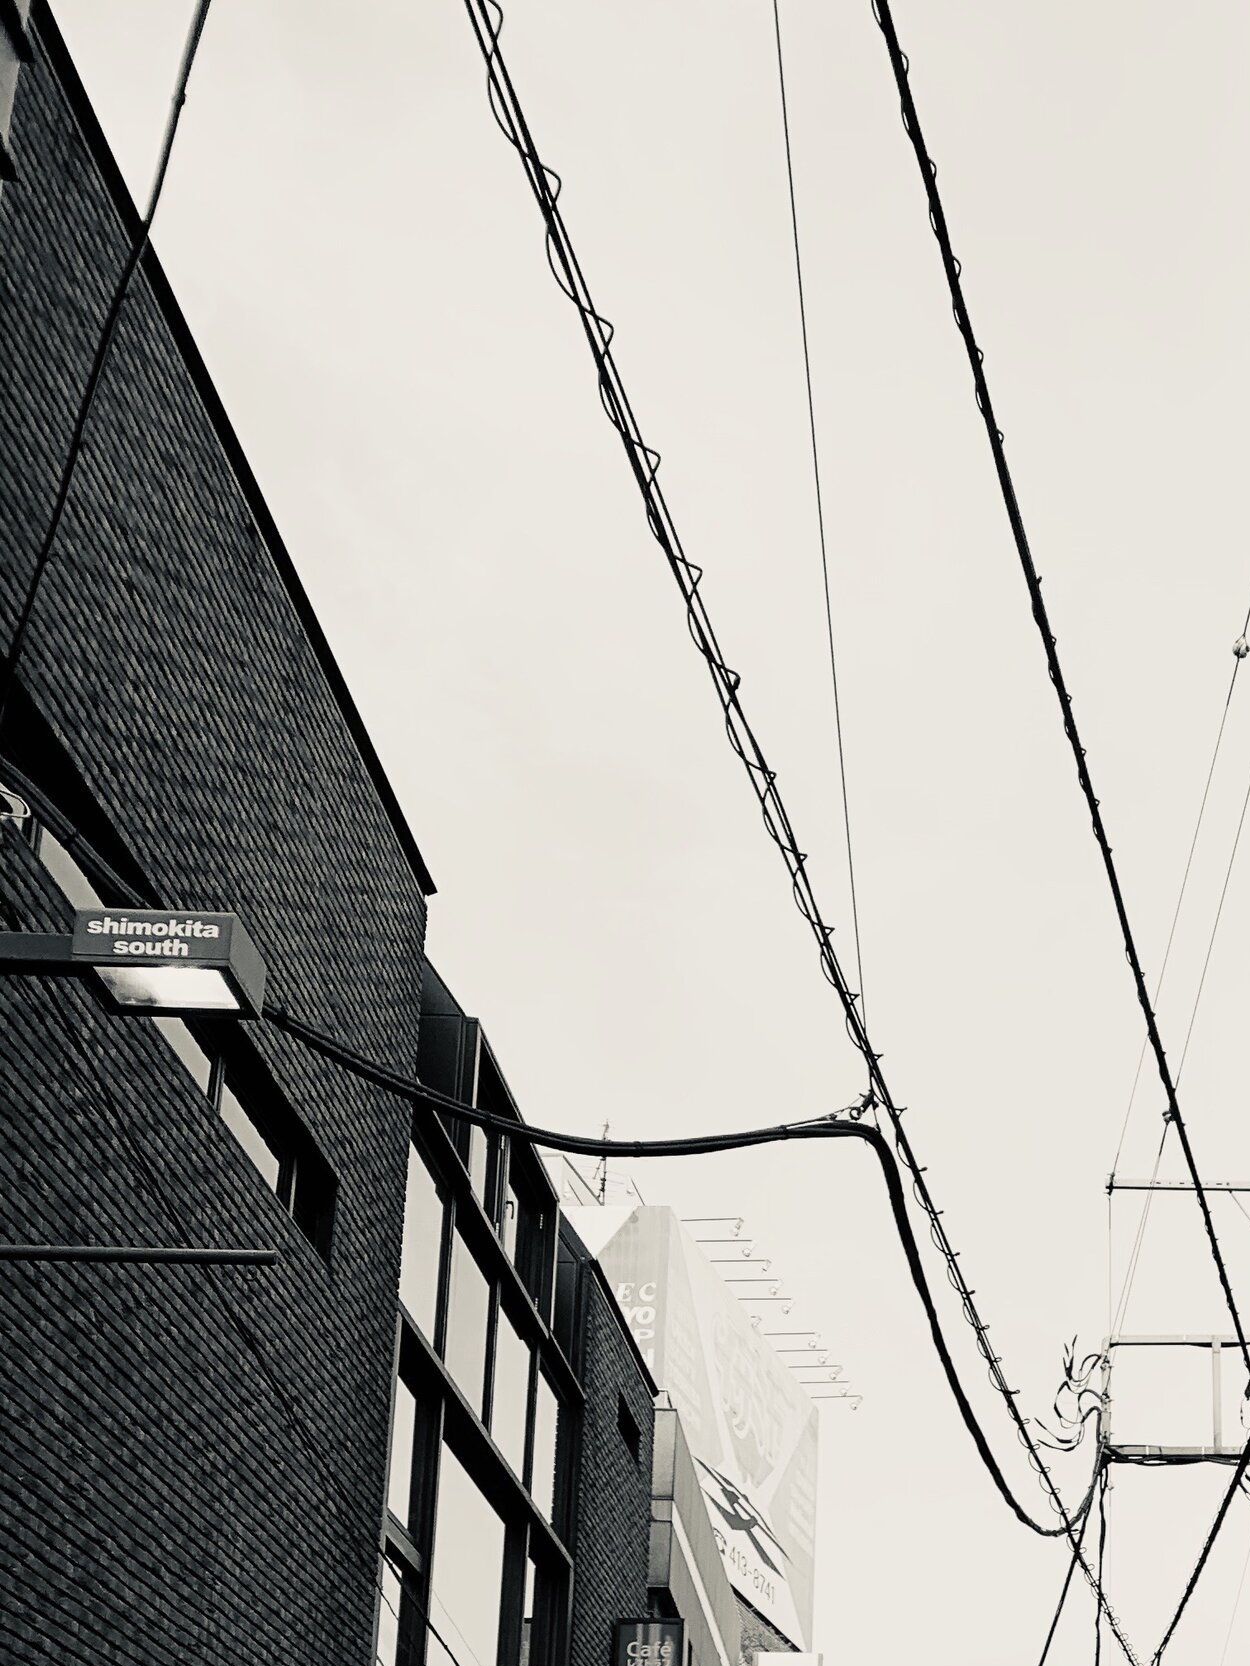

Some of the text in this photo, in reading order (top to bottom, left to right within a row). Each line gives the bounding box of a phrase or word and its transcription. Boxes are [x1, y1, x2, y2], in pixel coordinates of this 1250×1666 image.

[86, 917, 219, 938] shimokita
[113, 938, 188, 956] south
[627, 1641, 671, 1657] Café
